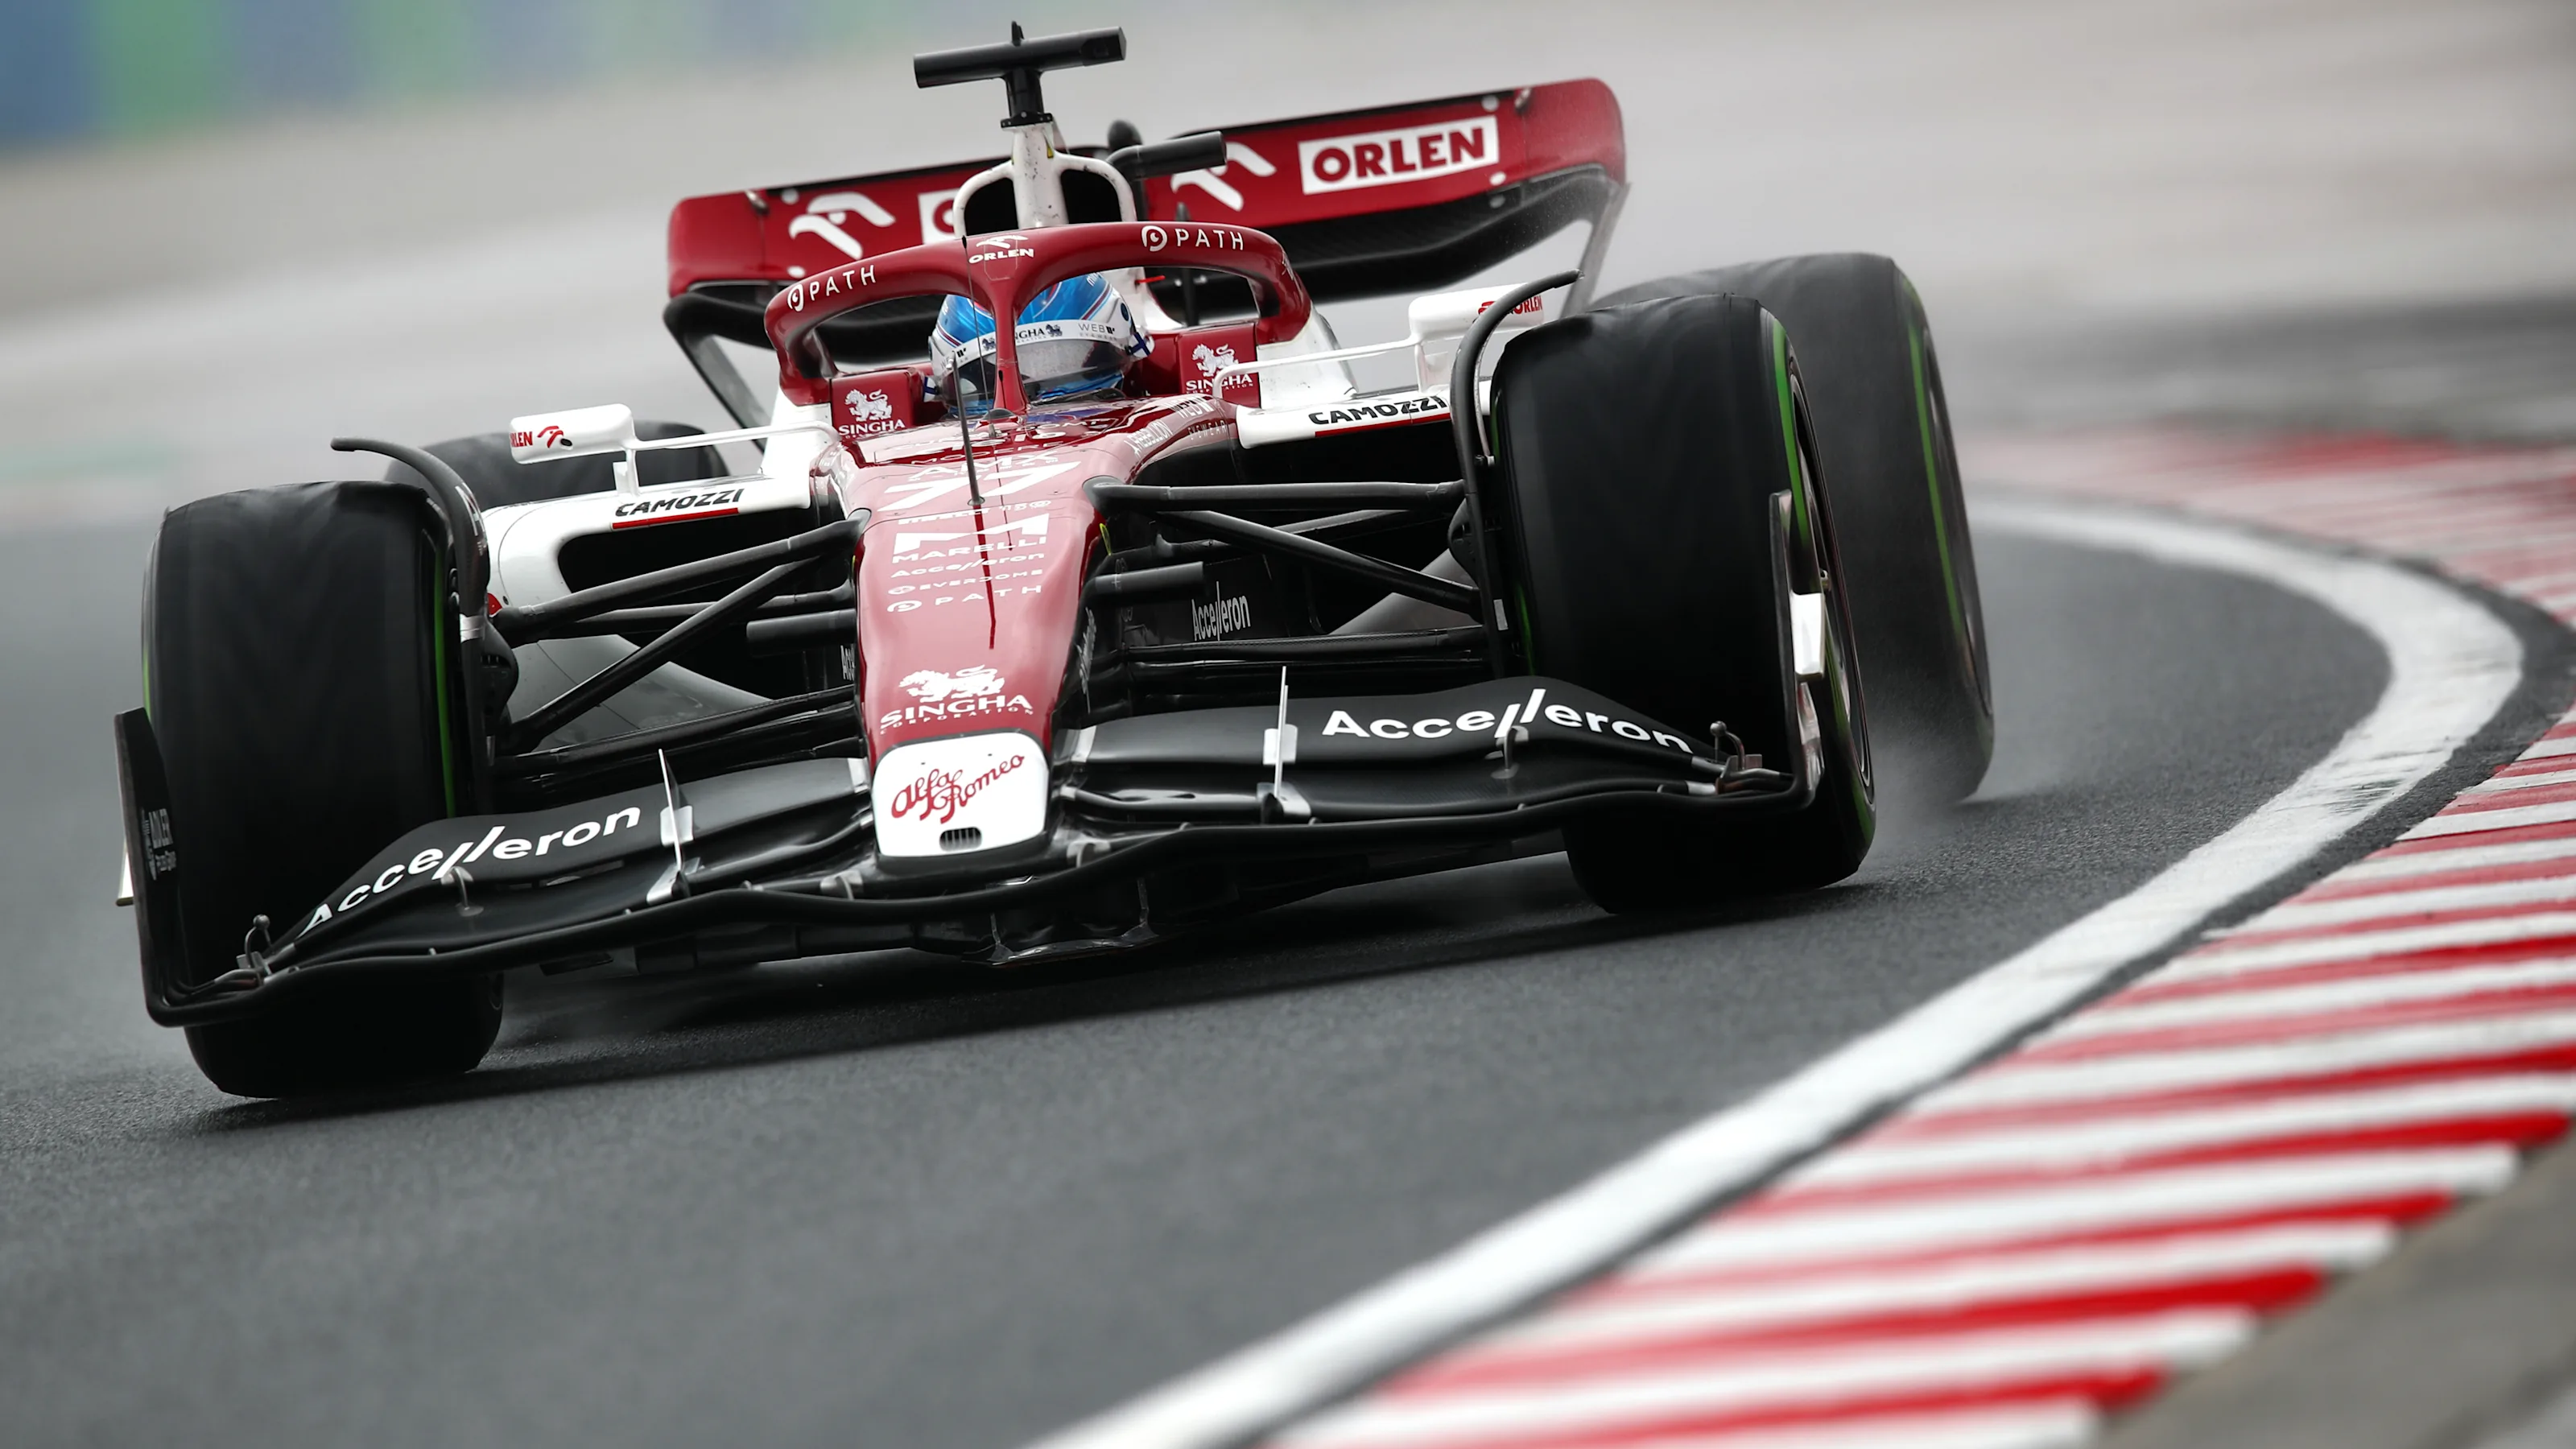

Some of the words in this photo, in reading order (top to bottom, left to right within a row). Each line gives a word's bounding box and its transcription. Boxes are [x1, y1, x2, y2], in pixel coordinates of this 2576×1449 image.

[1312, 126, 1485, 184] ORLEN
[1174, 228, 1245, 250] PATH
[968, 248, 1034, 264] ORLEN
[809, 264, 876, 301] PATH
[1186, 374, 1253, 391] SINGHA
[1308, 395, 1447, 425] CAMOZZI
[838, 419, 906, 436] SINGHA
[877, 460, 1082, 512] 77
[615, 488, 745, 517] CAMOZZI
[892, 536, 1047, 564] MARELLI
[891, 552, 1045, 578] Accelleron
[919, 568, 1043, 591] EVERDOME
[935, 584, 1042, 605] PATH
[1191, 580, 1252, 642] Accelleron
[880, 694, 1033, 729] SINGHA
[1322, 688, 1694, 754] Accelleron
[891, 768, 956, 821] Alfa
[932, 754, 1026, 824] Romeo
[297, 806, 642, 939] Accelleron
